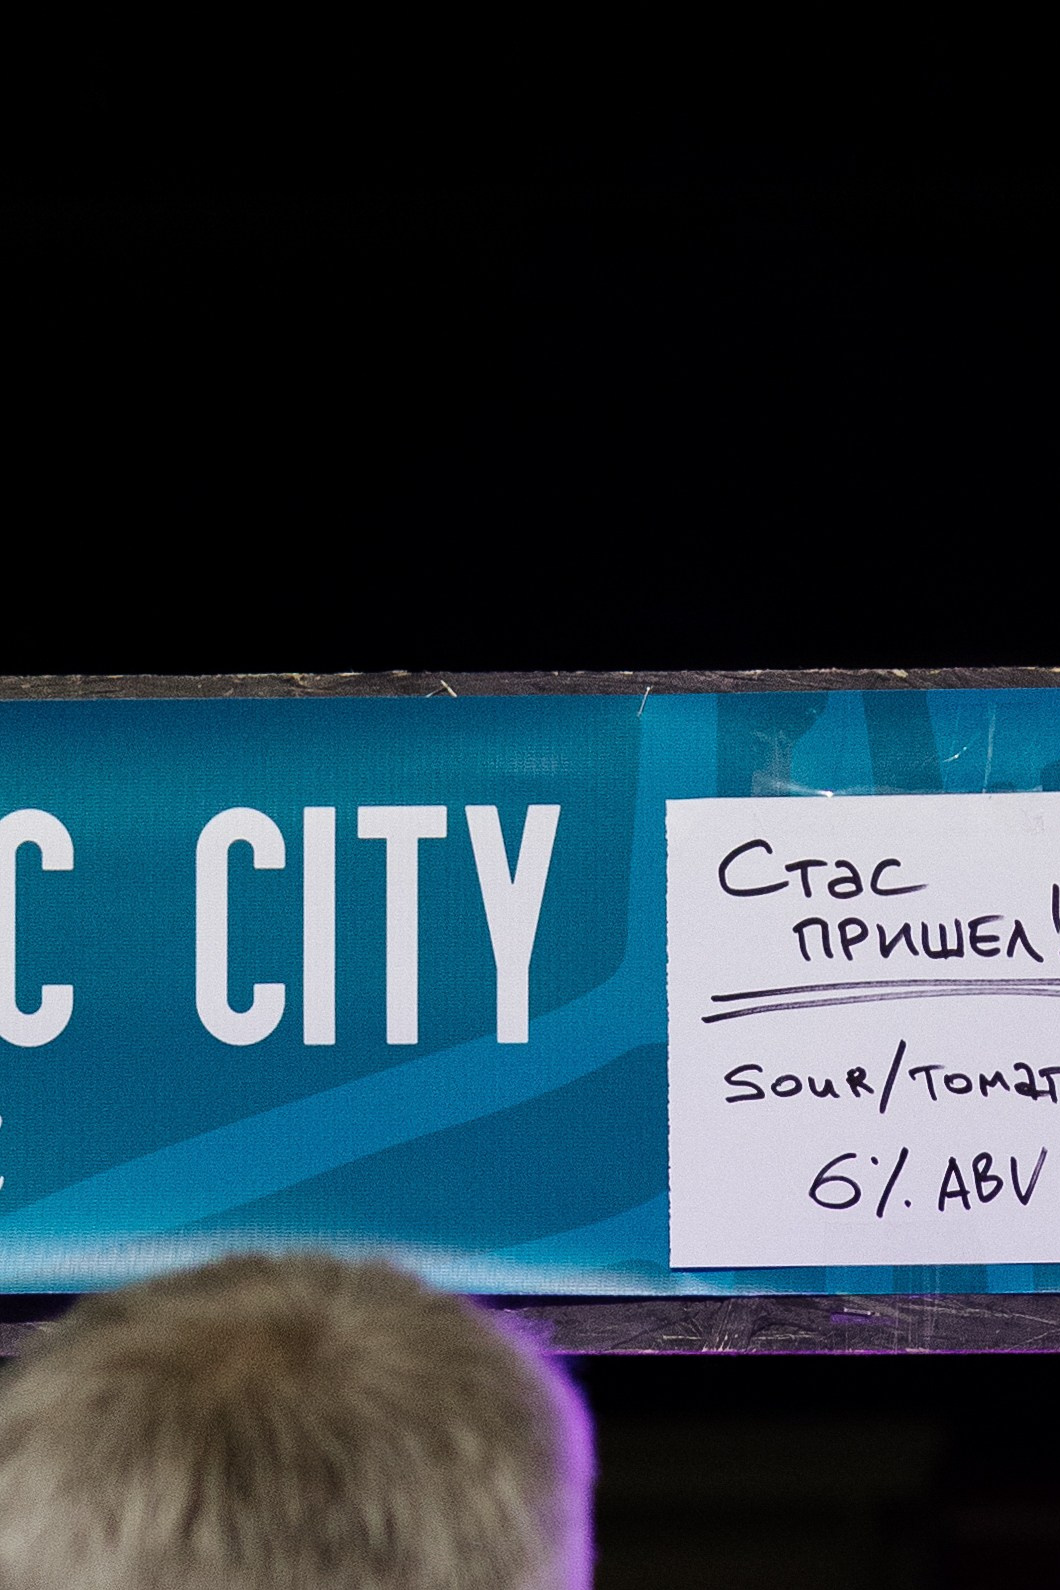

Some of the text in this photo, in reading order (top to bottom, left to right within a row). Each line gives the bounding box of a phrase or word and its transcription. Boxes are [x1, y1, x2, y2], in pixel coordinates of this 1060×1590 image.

[717, 838, 928, 900] Стас
[195, 803, 562, 1047] CITY
[808, 1146, 1048, 1219] 6% ABV
